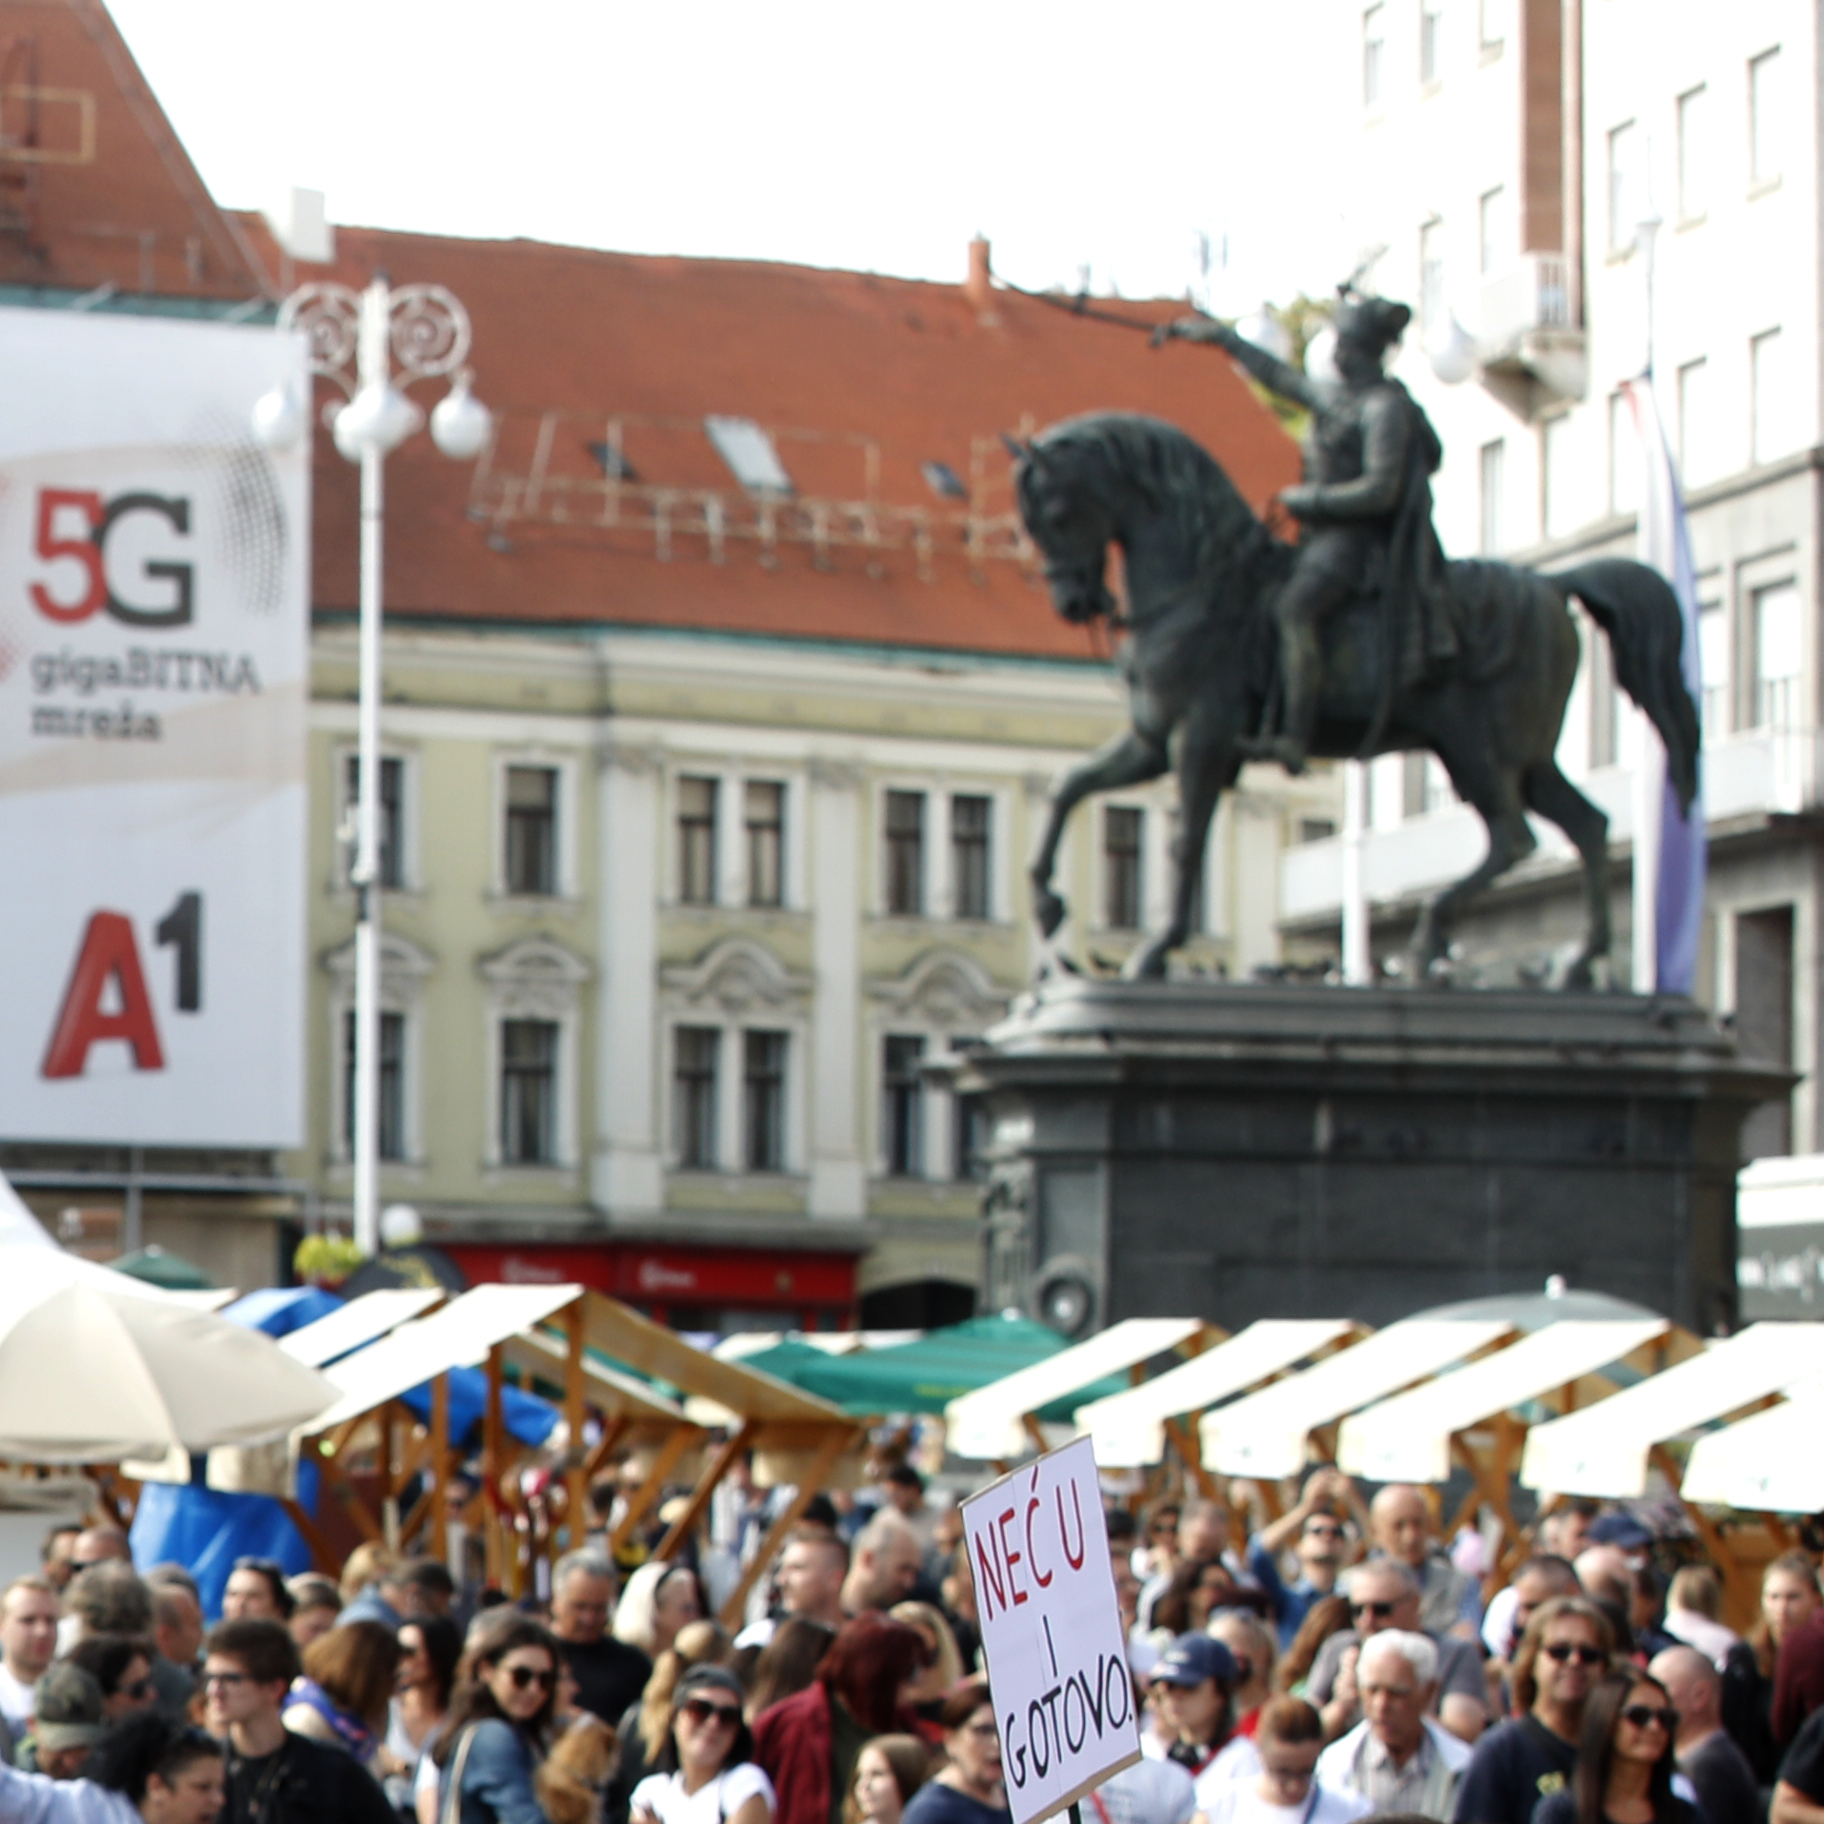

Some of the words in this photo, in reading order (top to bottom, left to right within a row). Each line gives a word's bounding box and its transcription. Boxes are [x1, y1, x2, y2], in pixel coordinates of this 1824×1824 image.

[27, 486, 194, 632] 5G
[29, 646, 263, 697] gigaBITNA
[30, 699, 162, 743] mreža
[40, 890, 205, 1080] A1
[1005, 1652, 1134, 1790] GOTOVO.
